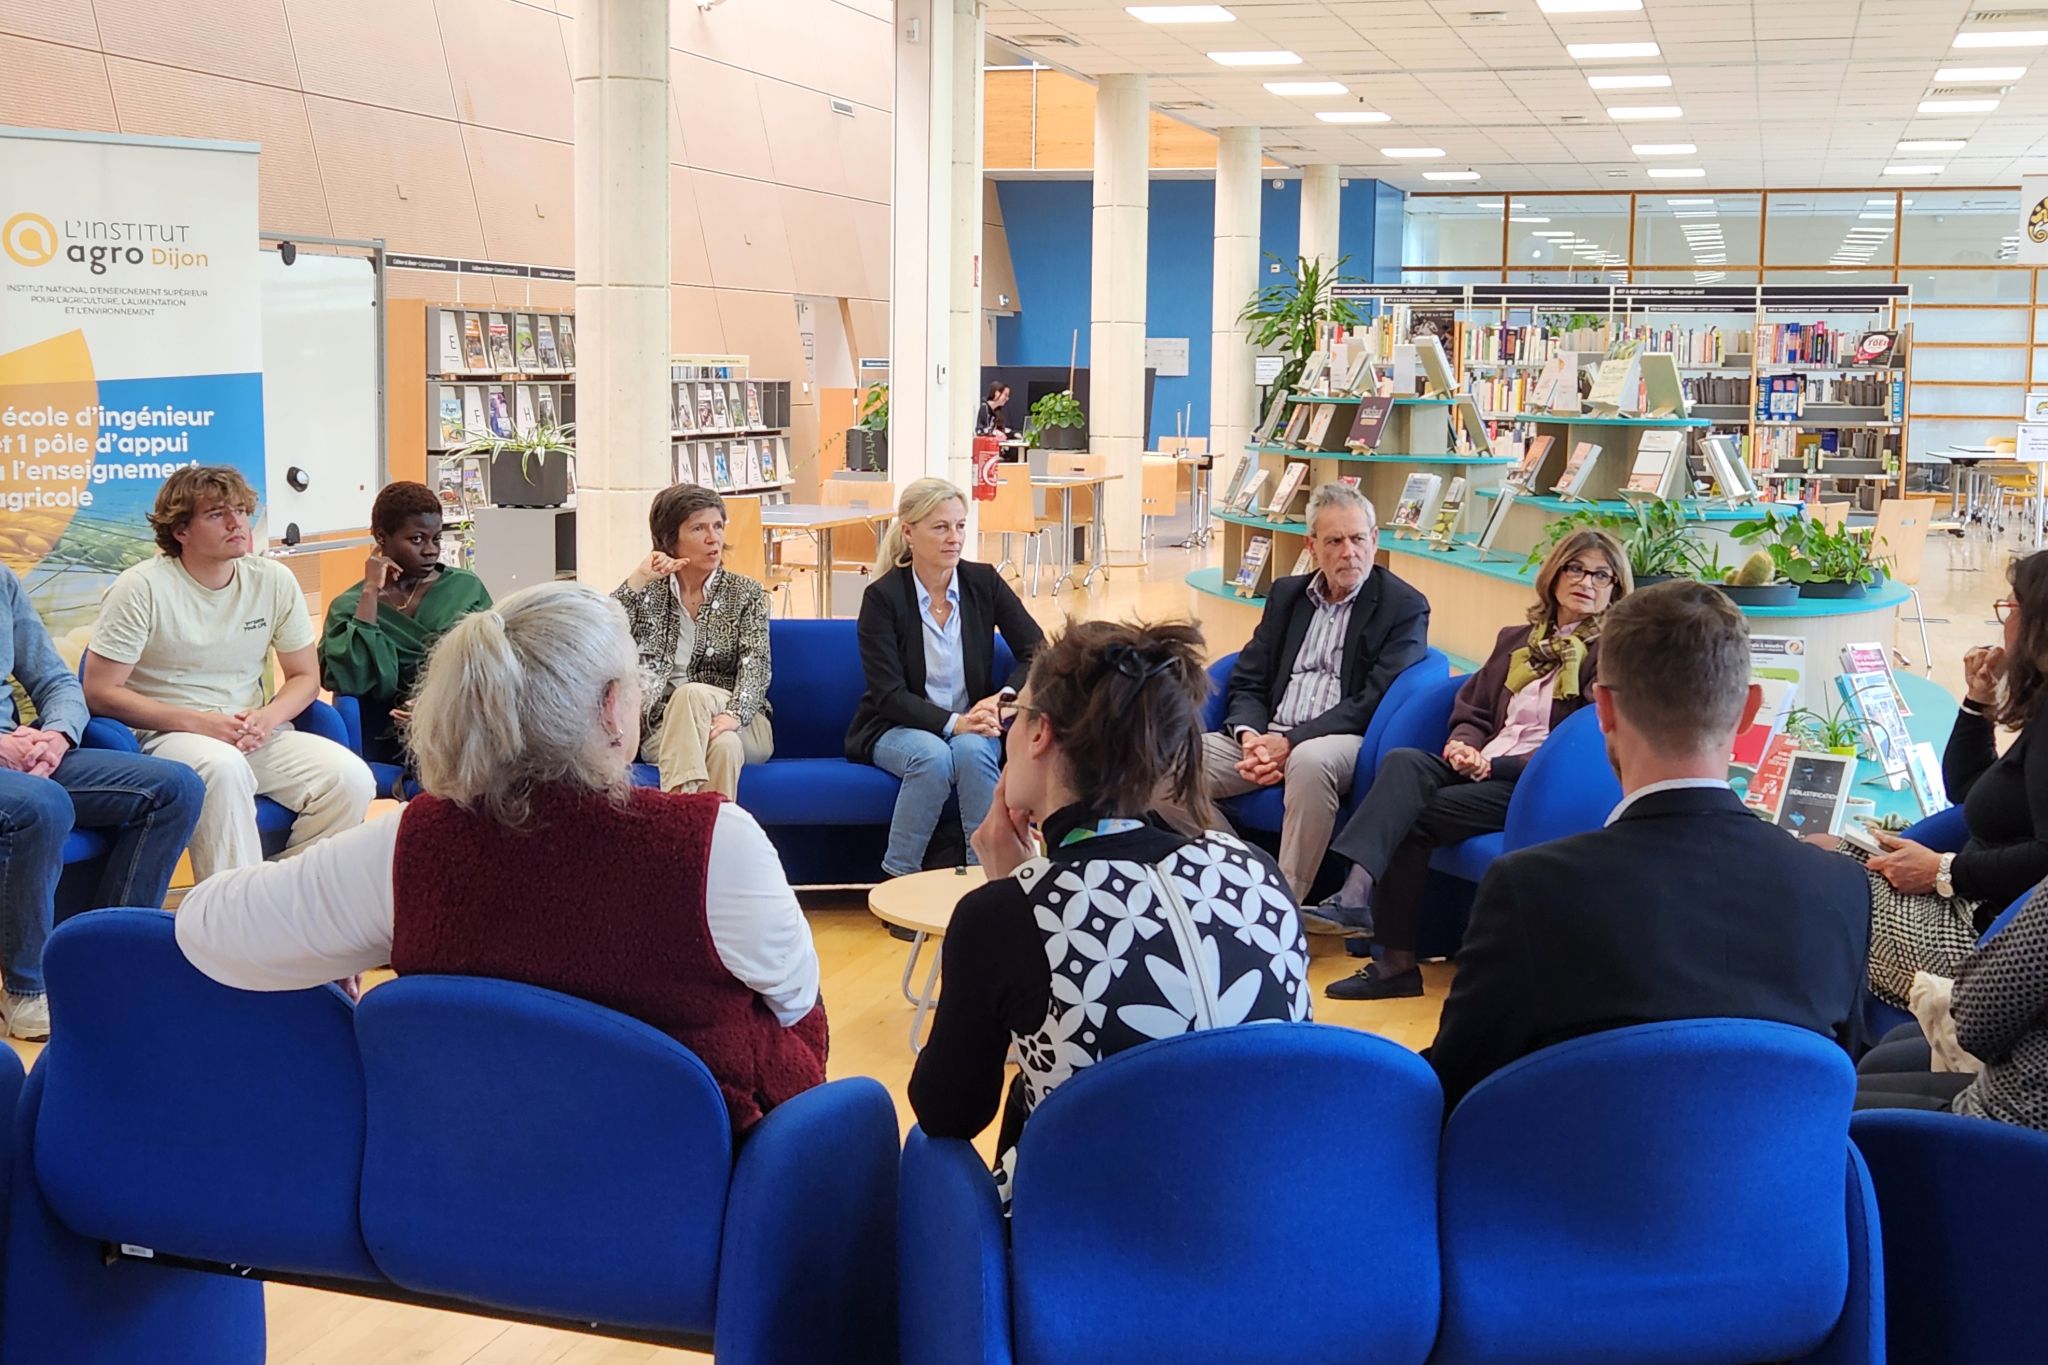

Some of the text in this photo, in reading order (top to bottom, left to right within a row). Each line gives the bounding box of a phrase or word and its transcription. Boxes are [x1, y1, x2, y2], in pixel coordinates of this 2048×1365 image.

[67, 244, 209, 275] agro Dijon
[6, 284, 45, 294] INSTITUT
[45, 285, 89, 295] NATIONAL
[90, 286, 162, 297] D'ENSEIGNEMENT
[31, 295, 56, 304] POUR
[121, 297, 187, 307] L'ALIMENTATION
[65, 307, 155, 317] ET L'ENVIRONNEMENT
[2, 405, 215, 431] école d'ingénieur
[0, 431, 189, 458] t 1 pôle d'appui
